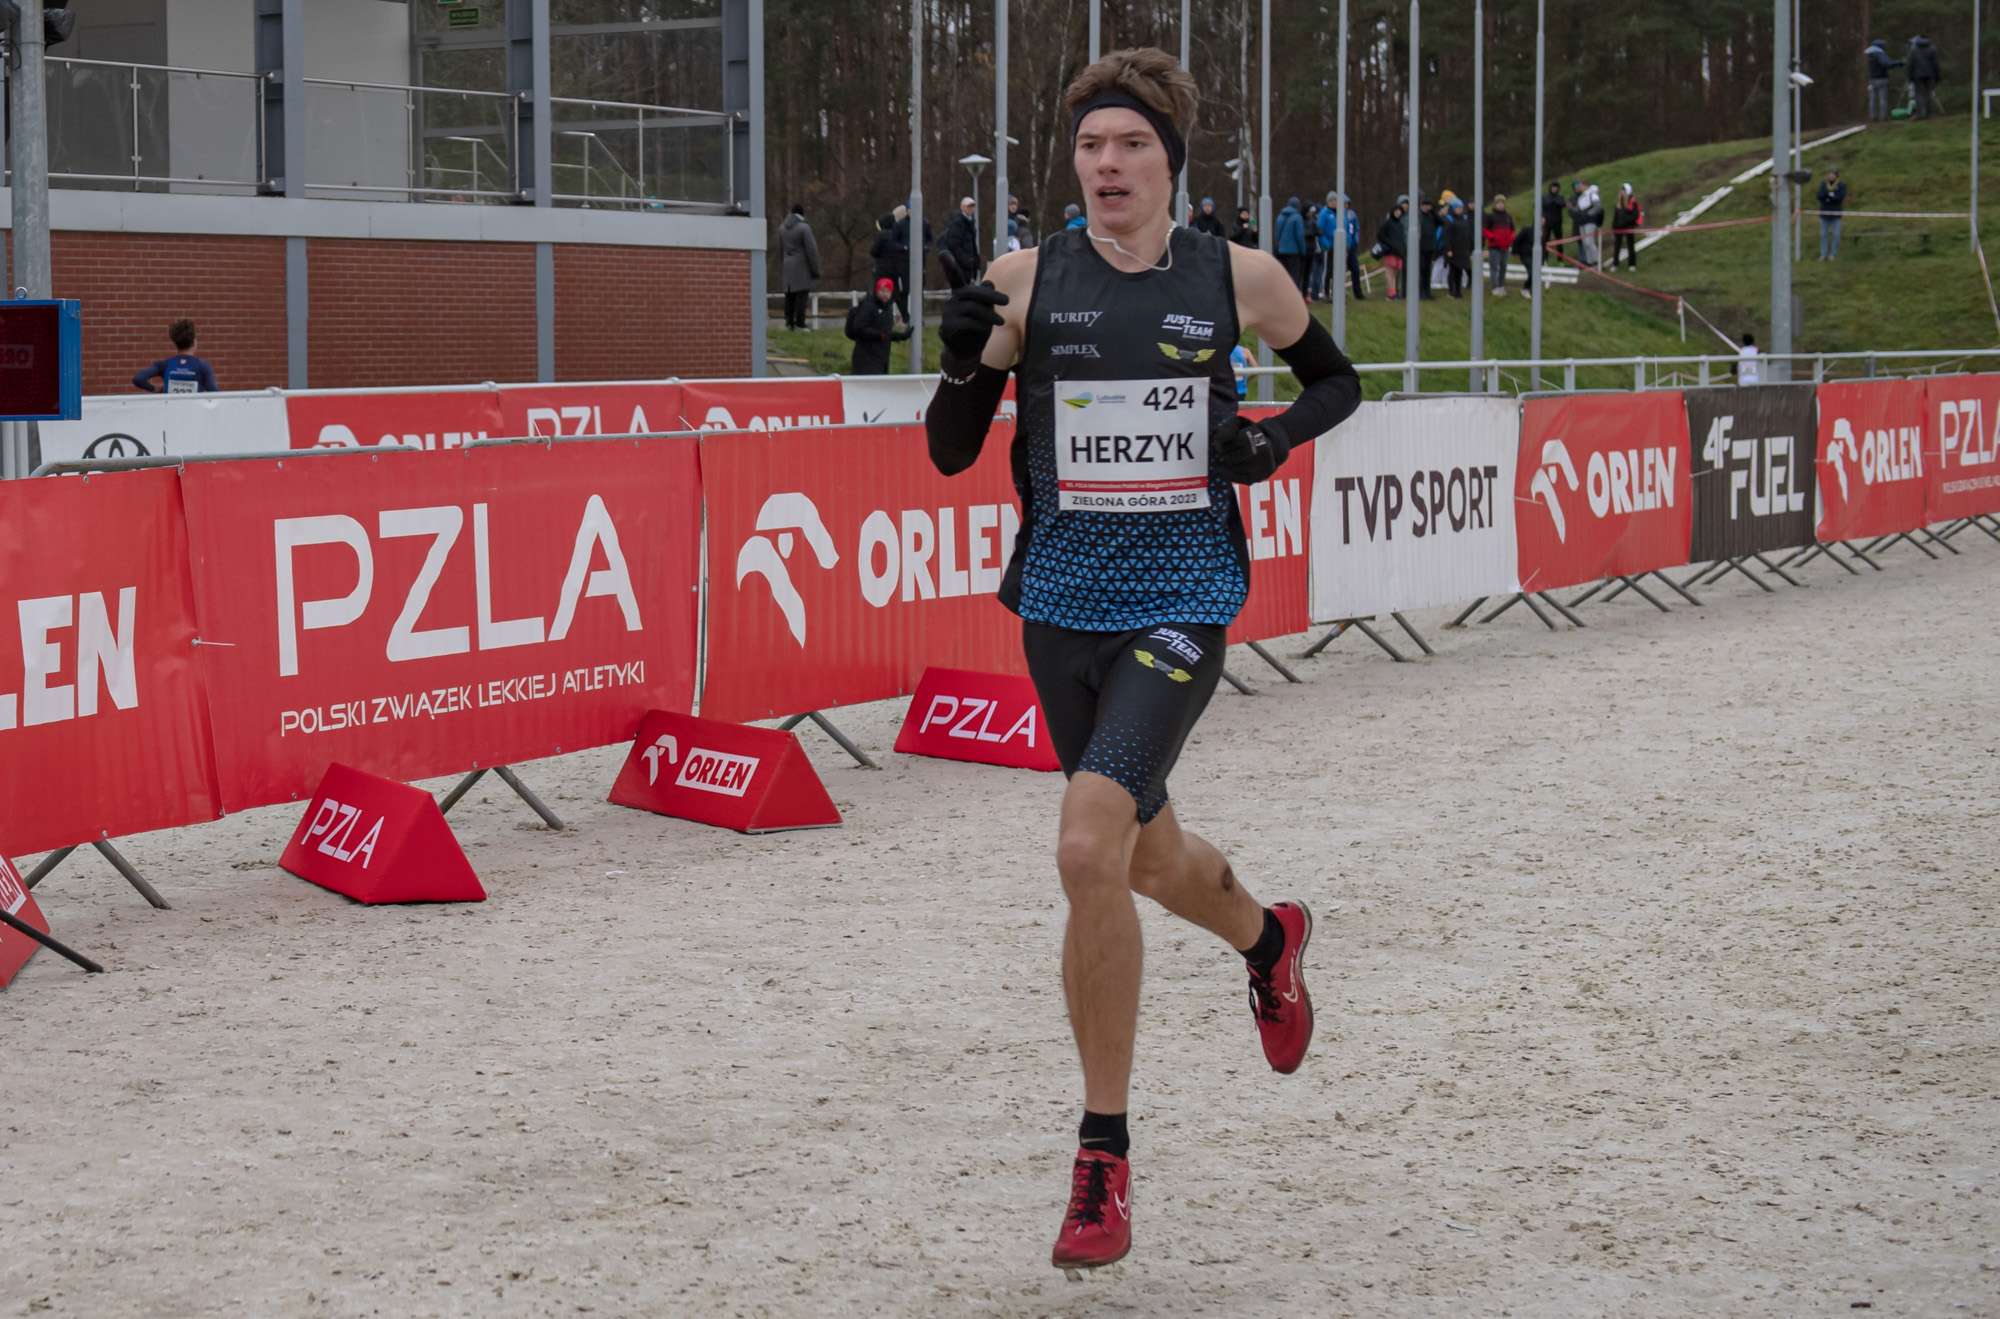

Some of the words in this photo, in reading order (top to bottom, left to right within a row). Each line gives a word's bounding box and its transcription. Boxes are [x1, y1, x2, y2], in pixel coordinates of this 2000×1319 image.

[1050, 311, 1102, 327] PURITY
[1163, 314, 1194, 325] JUST
[1182, 324, 1213, 337] TEAM
[1050, 344, 1102, 358] SIMPLEX
[1143, 385, 1195, 411] 424
[1070, 432, 1195, 463] HERZYK
[1703, 415, 1734, 469] 4F
[1862, 426, 1923, 486] ORLEN
[1072, 496, 1125, 507] ZIELONA
[1128, 494, 1168, 507] GÓRA
[1170, 493, 1197, 505] 2023
[1587, 446, 1676, 518] ORLEN
[1731, 436, 1805, 520] FUEL
[1233, 478, 1303, 561] EN
[1334, 474, 1403, 544] TVP
[1410, 465, 1498, 537] SPORT
[274, 494, 643, 677] PZLA
[1153, 627, 1188, 641] JUST
[1170, 638, 1201, 662] TEAM
[281, 701, 366, 737] POLSKI
[372, 685, 473, 720] ZWIĄZEK
[478, 672, 556, 708] LEKKIEJ
[563, 661, 645, 695] ATLETYKI
[919, 694, 1036, 748] PZLA
[685, 754, 752, 790] ORLEN
[301, 797, 384, 869] PZLA
